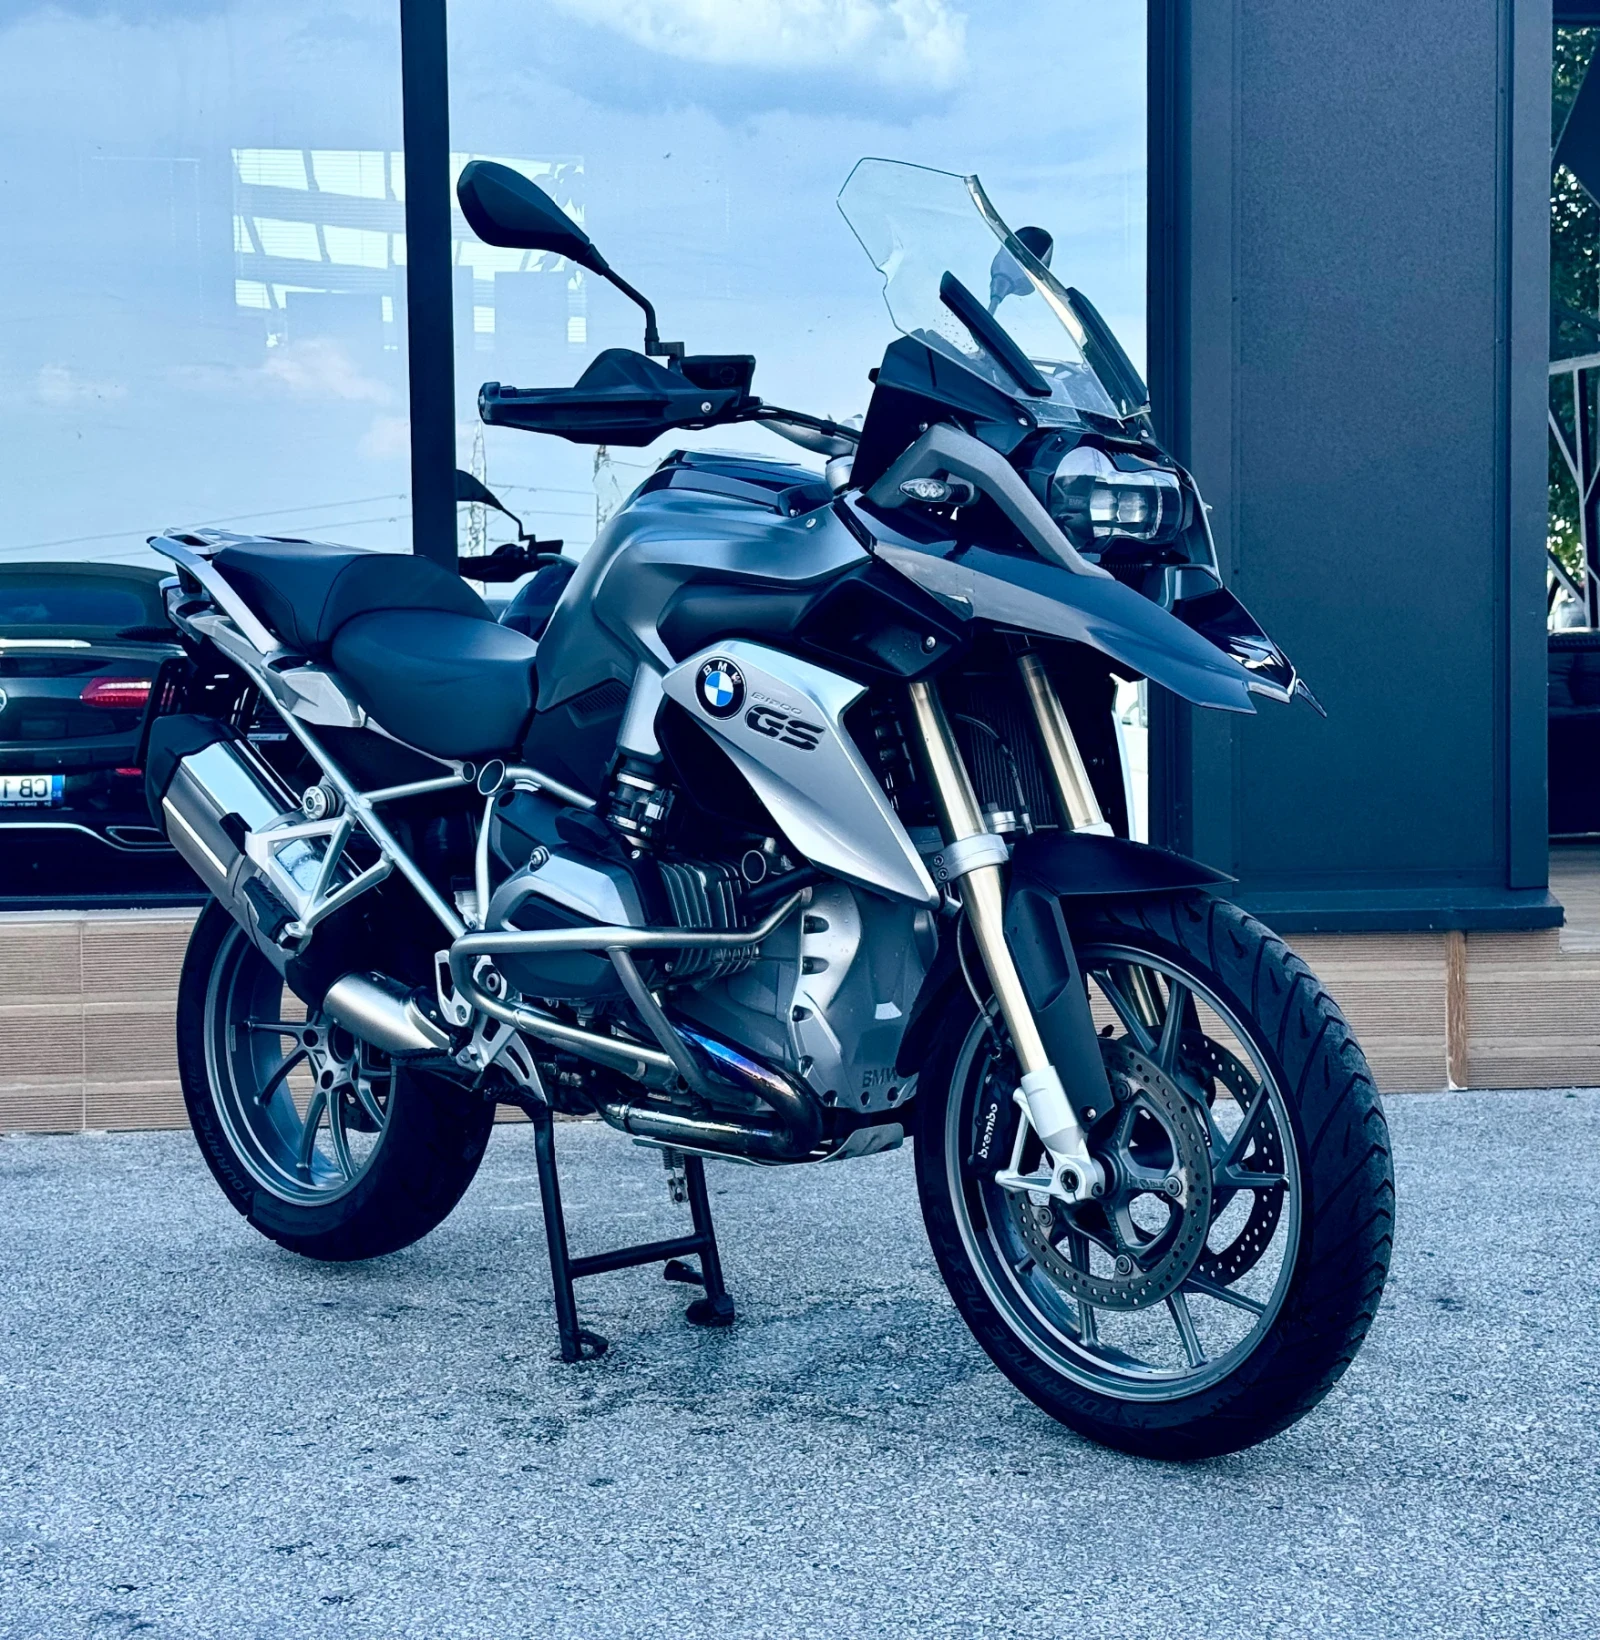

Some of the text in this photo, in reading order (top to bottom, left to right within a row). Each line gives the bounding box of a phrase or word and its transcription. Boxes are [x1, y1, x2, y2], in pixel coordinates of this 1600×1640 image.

[702, 660, 742, 685] BMW
[745, 704, 826, 753] GS
[862, 1066, 898, 1088] BMW
[977, 1103, 998, 1159] brembo
[981, 1323, 1114, 1419] TOURANCE
